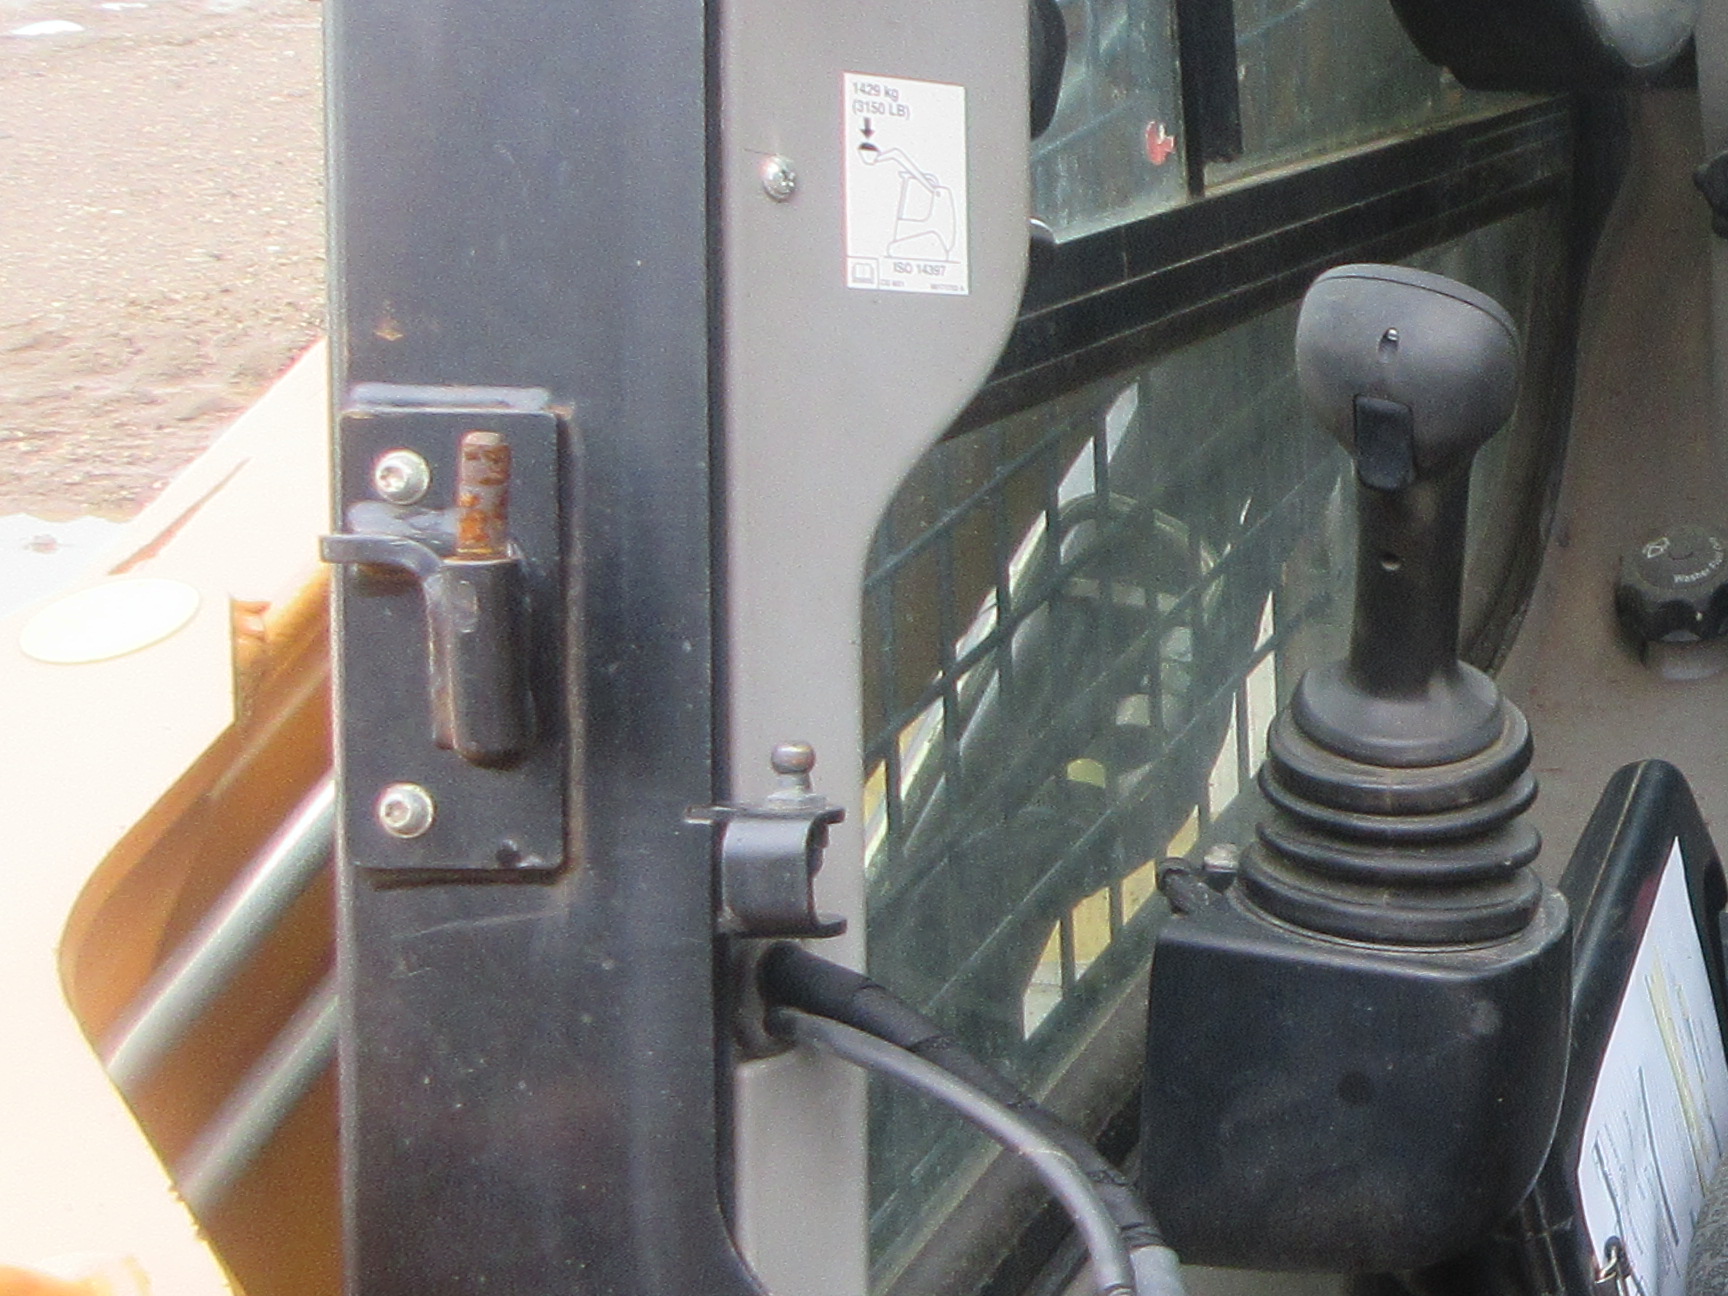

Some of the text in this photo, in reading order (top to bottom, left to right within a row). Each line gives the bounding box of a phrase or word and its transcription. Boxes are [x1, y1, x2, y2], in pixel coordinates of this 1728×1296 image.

[852, 82, 900, 103] 1429 kg
[852, 100, 911, 121] (3150 LB)
[893, 262, 913, 274] ISO
